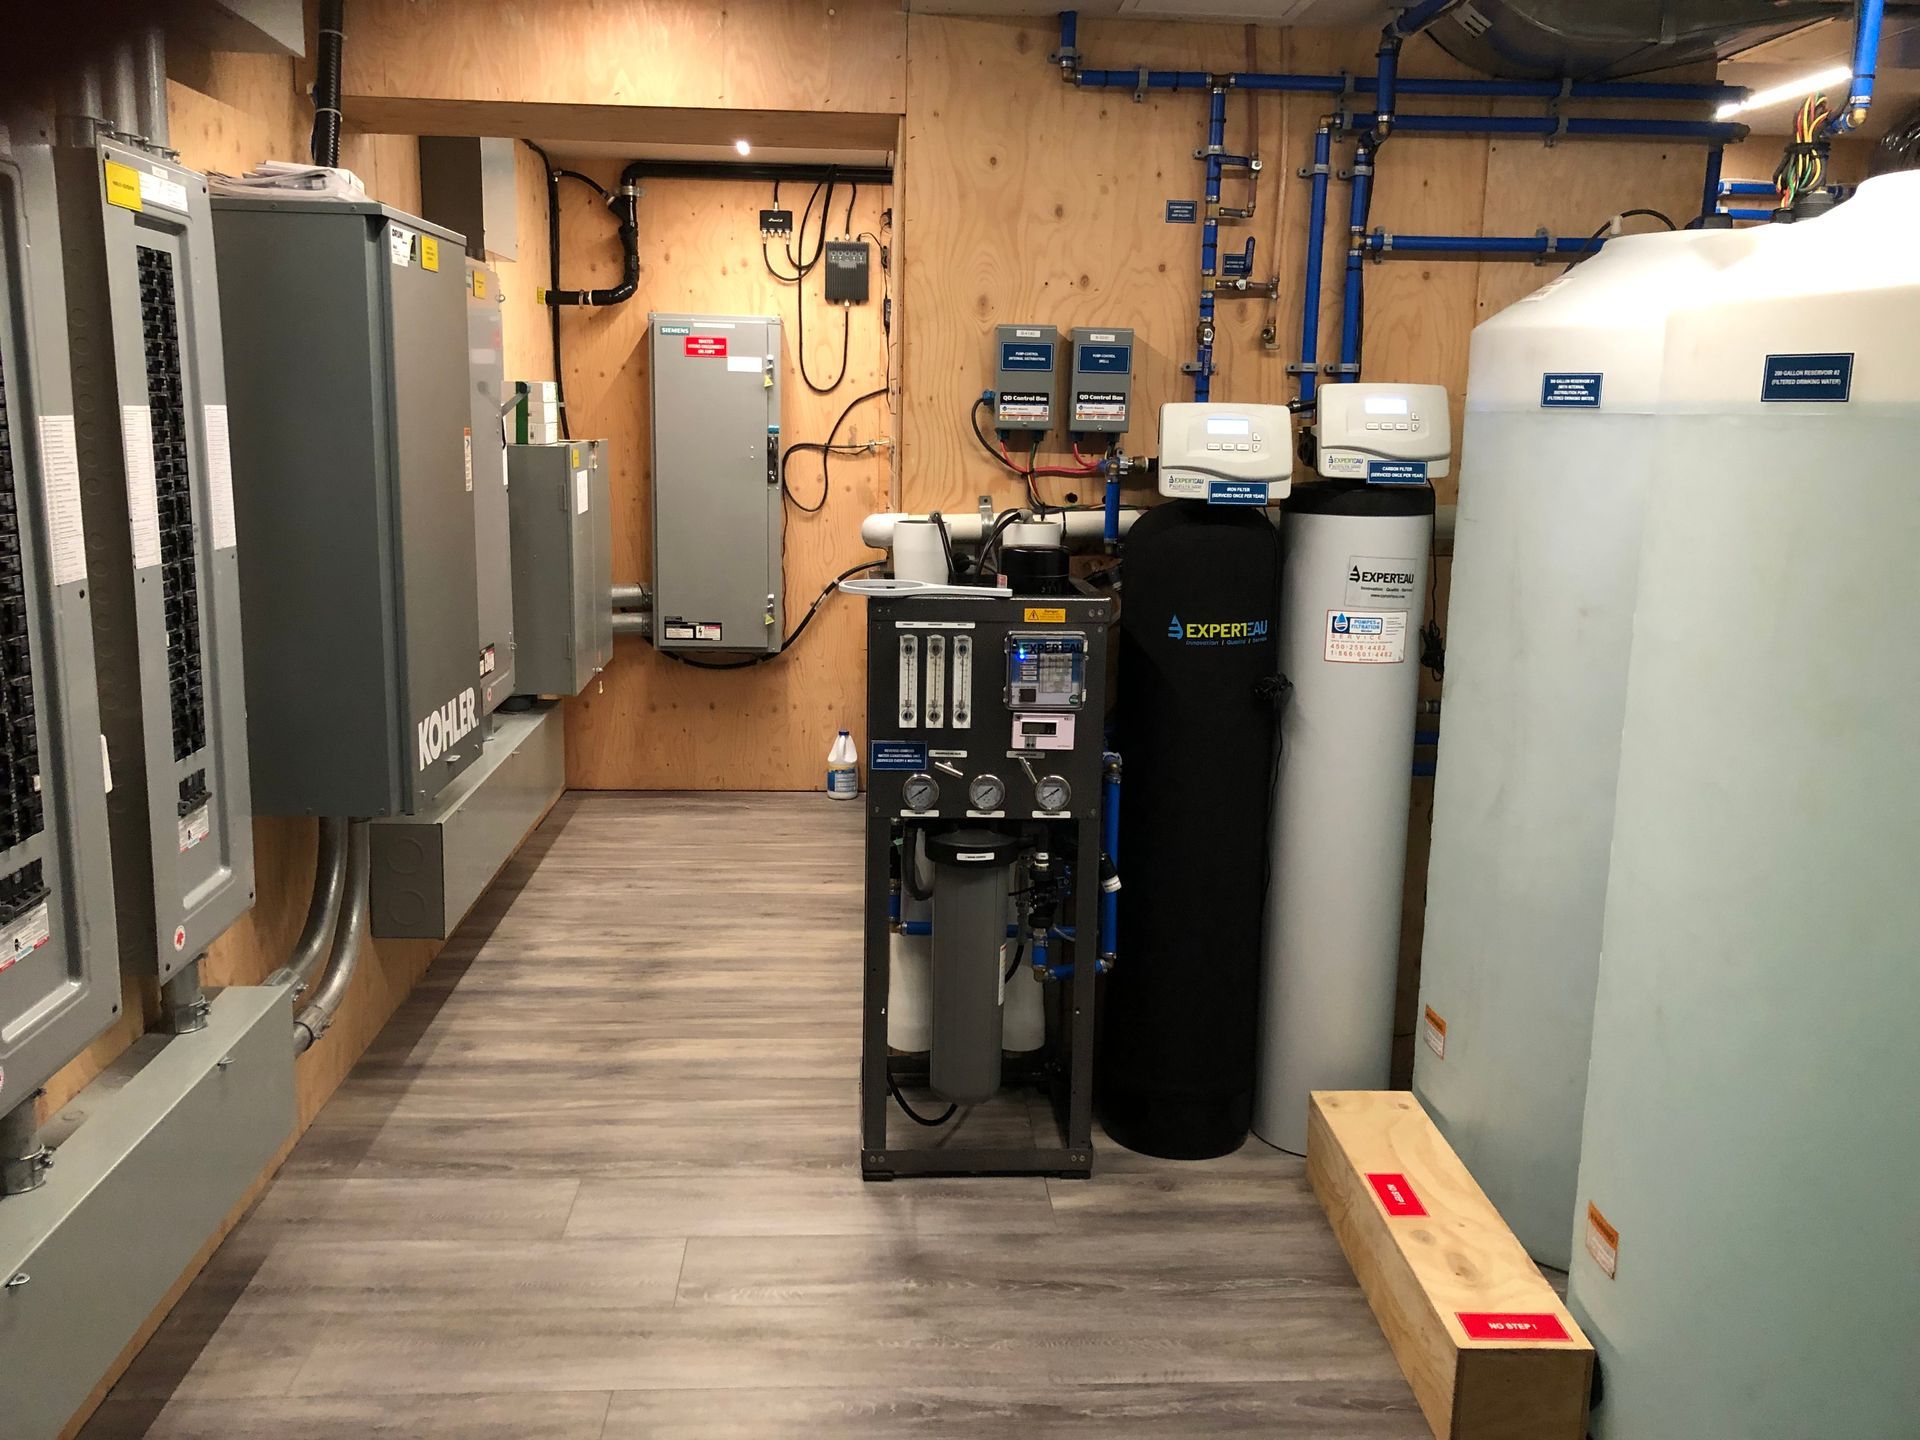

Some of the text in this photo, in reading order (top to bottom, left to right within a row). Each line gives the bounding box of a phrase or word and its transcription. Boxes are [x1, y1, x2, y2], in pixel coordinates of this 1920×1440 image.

[1362, 572, 1414, 584] EXPERTEAU
[1186, 620, 1268, 638] EXPERTEAU
[1391, 1191, 1405, 1203] STEP
